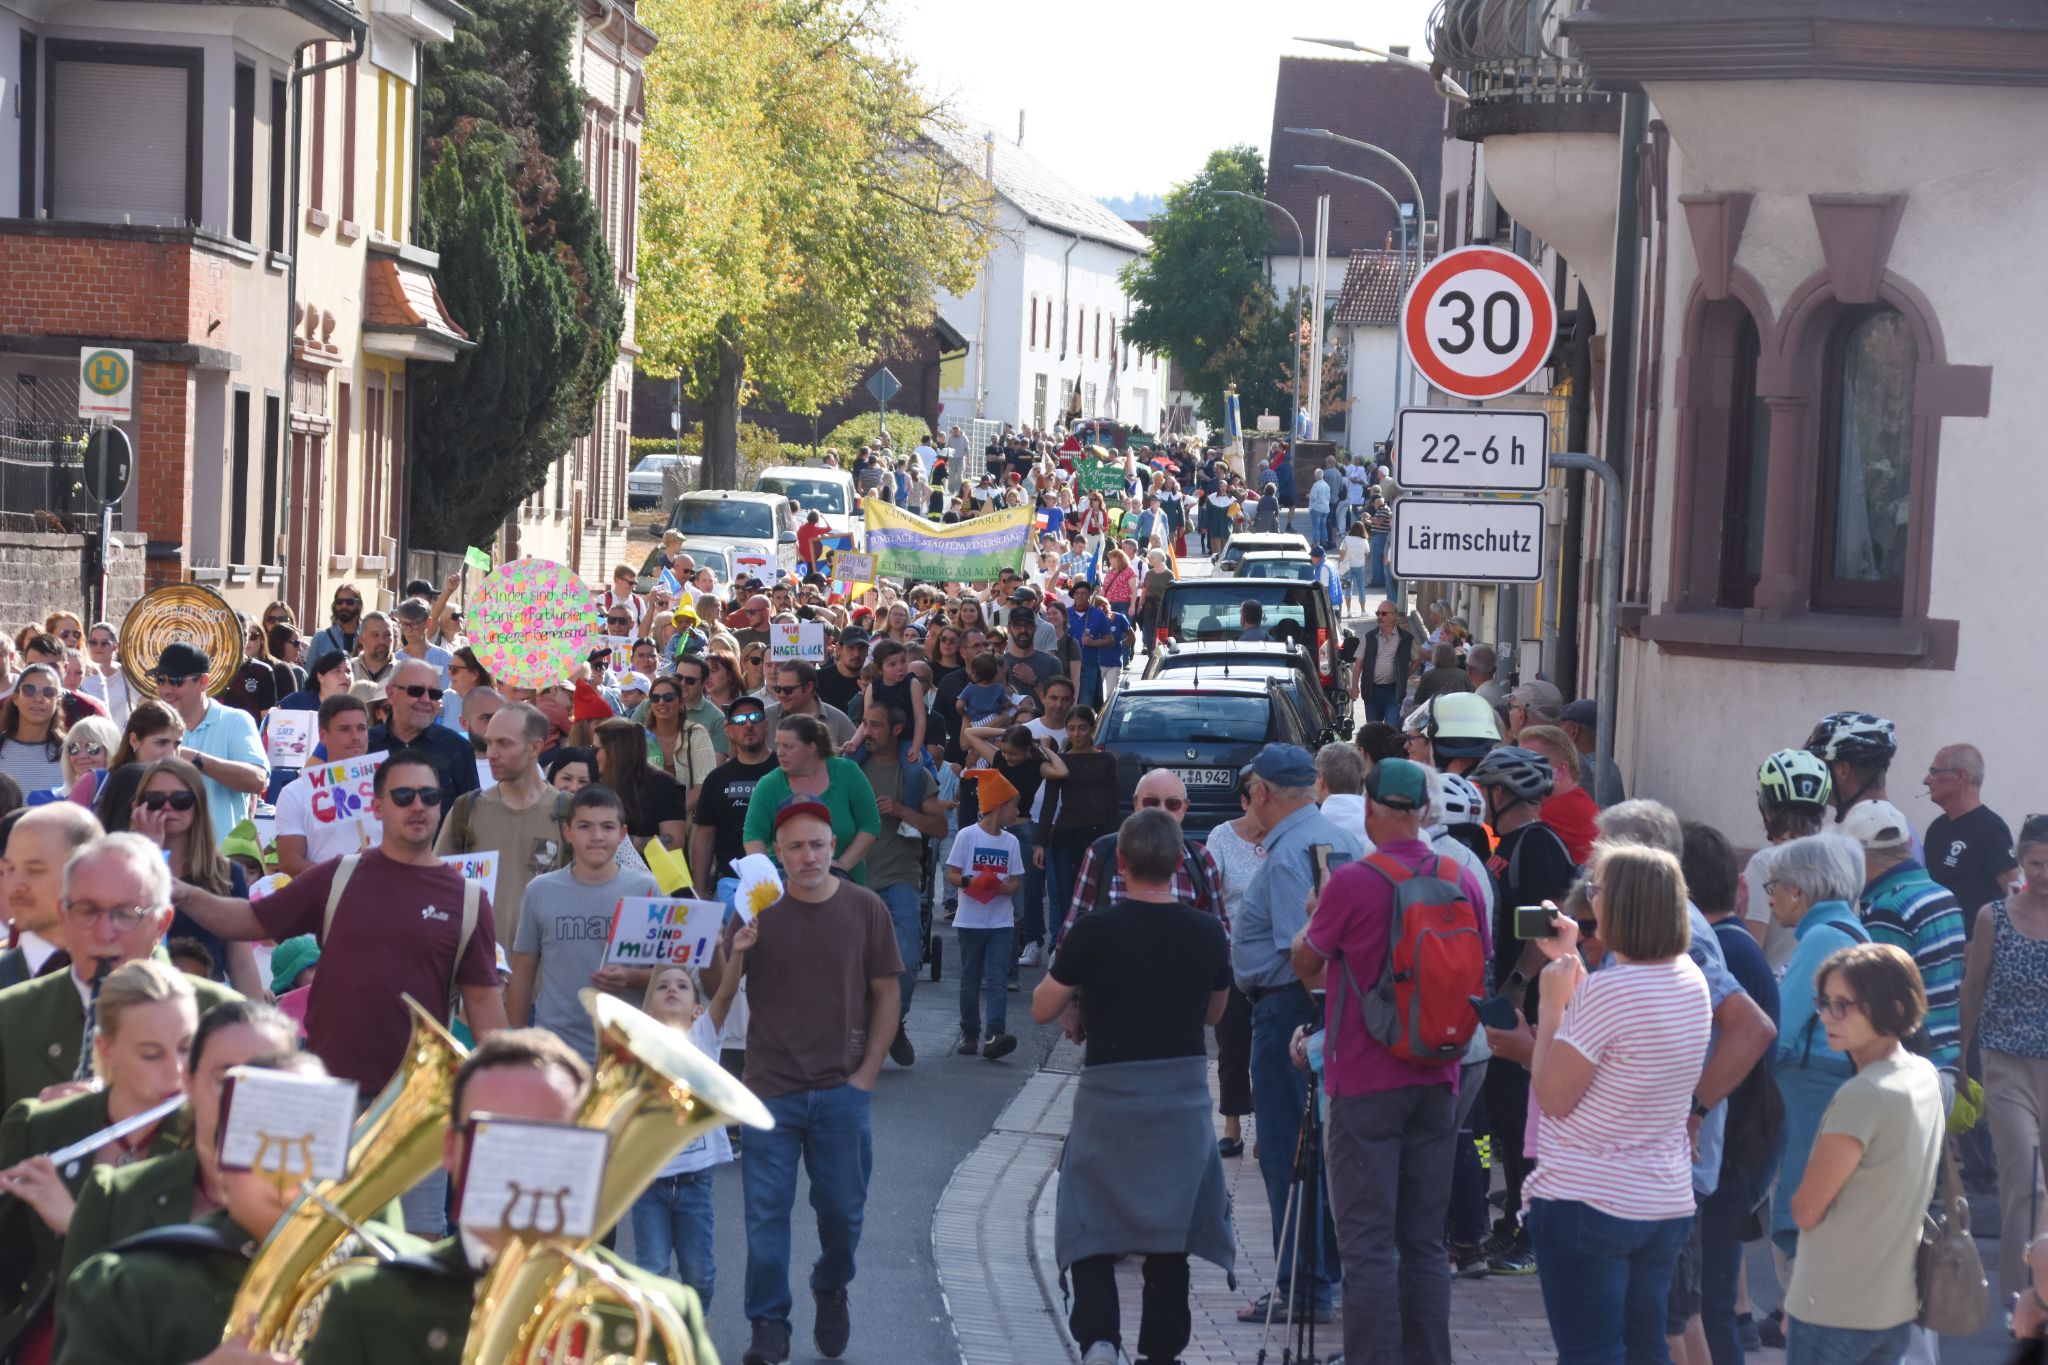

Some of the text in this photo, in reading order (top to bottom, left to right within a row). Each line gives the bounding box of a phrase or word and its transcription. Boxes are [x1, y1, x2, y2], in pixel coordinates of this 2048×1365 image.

[1437, 290, 1520, 355] 30
[95, 360, 117, 385] H
[1420, 433, 1525, 465] 22-6 h
[1407, 525, 1532, 553] Lärmschutz
[880, 560, 954, 577] KLINGENBERG
[955, 565, 972, 577] AM
[484, 583, 579, 604] Kinder sind die
[142, 597, 228, 624] Gemeinsam
[483, 630, 532, 646] unserer
[782, 625, 800, 634] WIR
[773, 643, 824, 657] NAGELLACK
[308, 765, 349, 790] WIR
[1194, 770, 1203, 784] A
[1205, 771, 1229, 784] 942
[465, 860, 491, 879] SIND
[647, 903, 689, 926] WIR
[555, 915, 614, 942] ma
